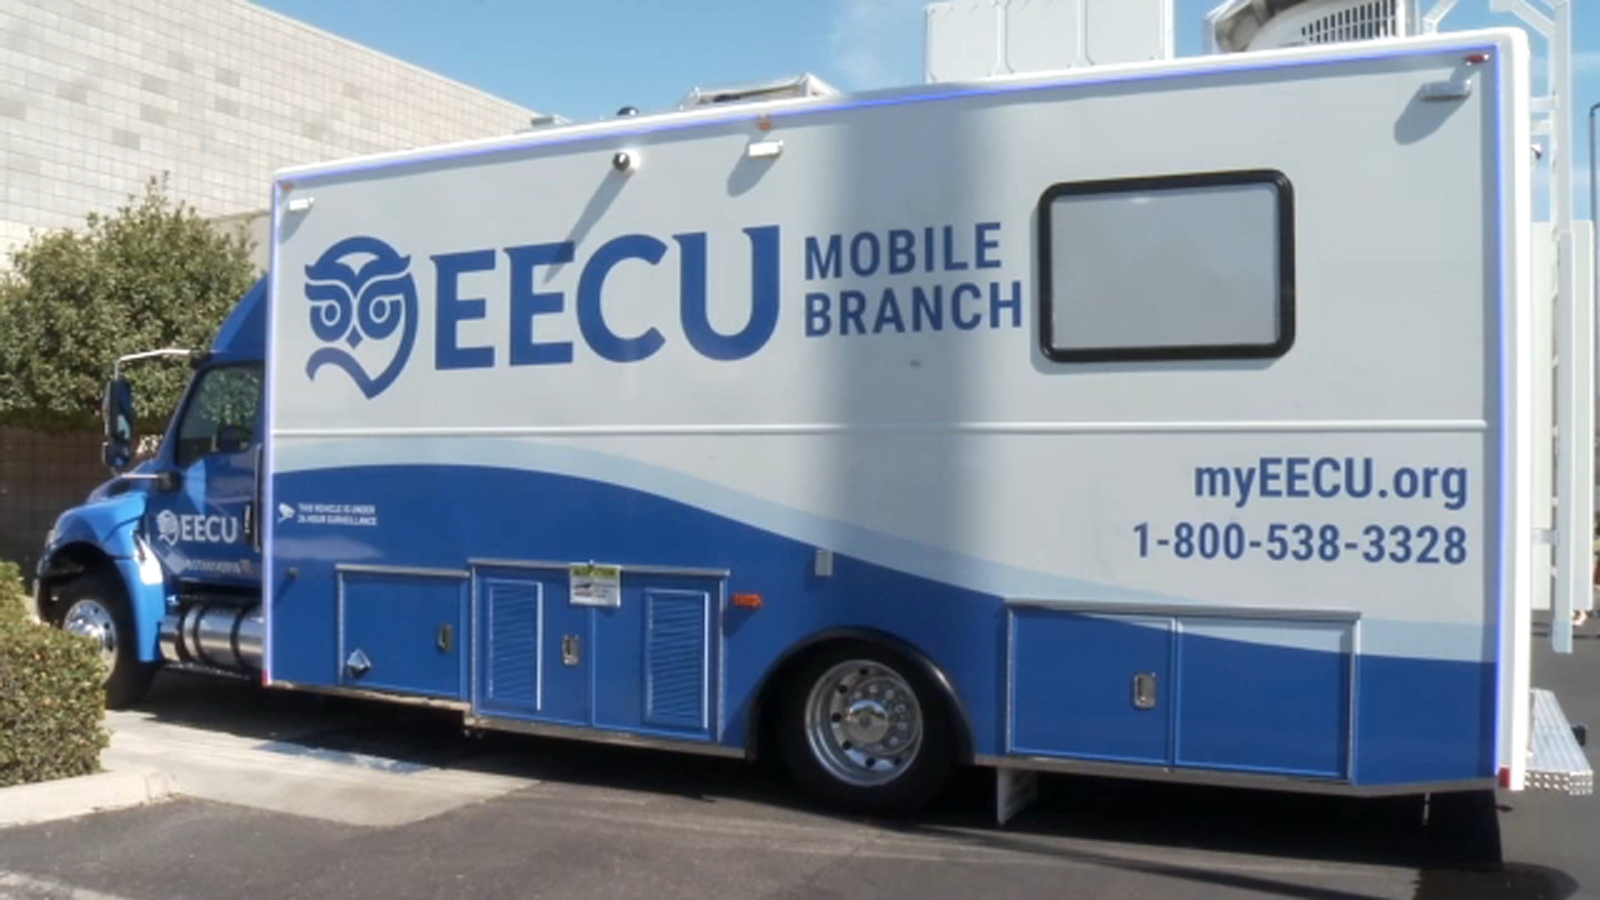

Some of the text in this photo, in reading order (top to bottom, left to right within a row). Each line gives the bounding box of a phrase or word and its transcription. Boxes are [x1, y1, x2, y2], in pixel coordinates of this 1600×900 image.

[805, 222, 1002, 280] MOBILE
[430, 225, 780, 370] EECU
[805, 280, 1022, 338] BRANCH
[1195, 457, 1468, 511] myEECU.org
[180, 514, 238, 544] EECU
[1134, 521, 1467, 565] 1-800-538-3328
